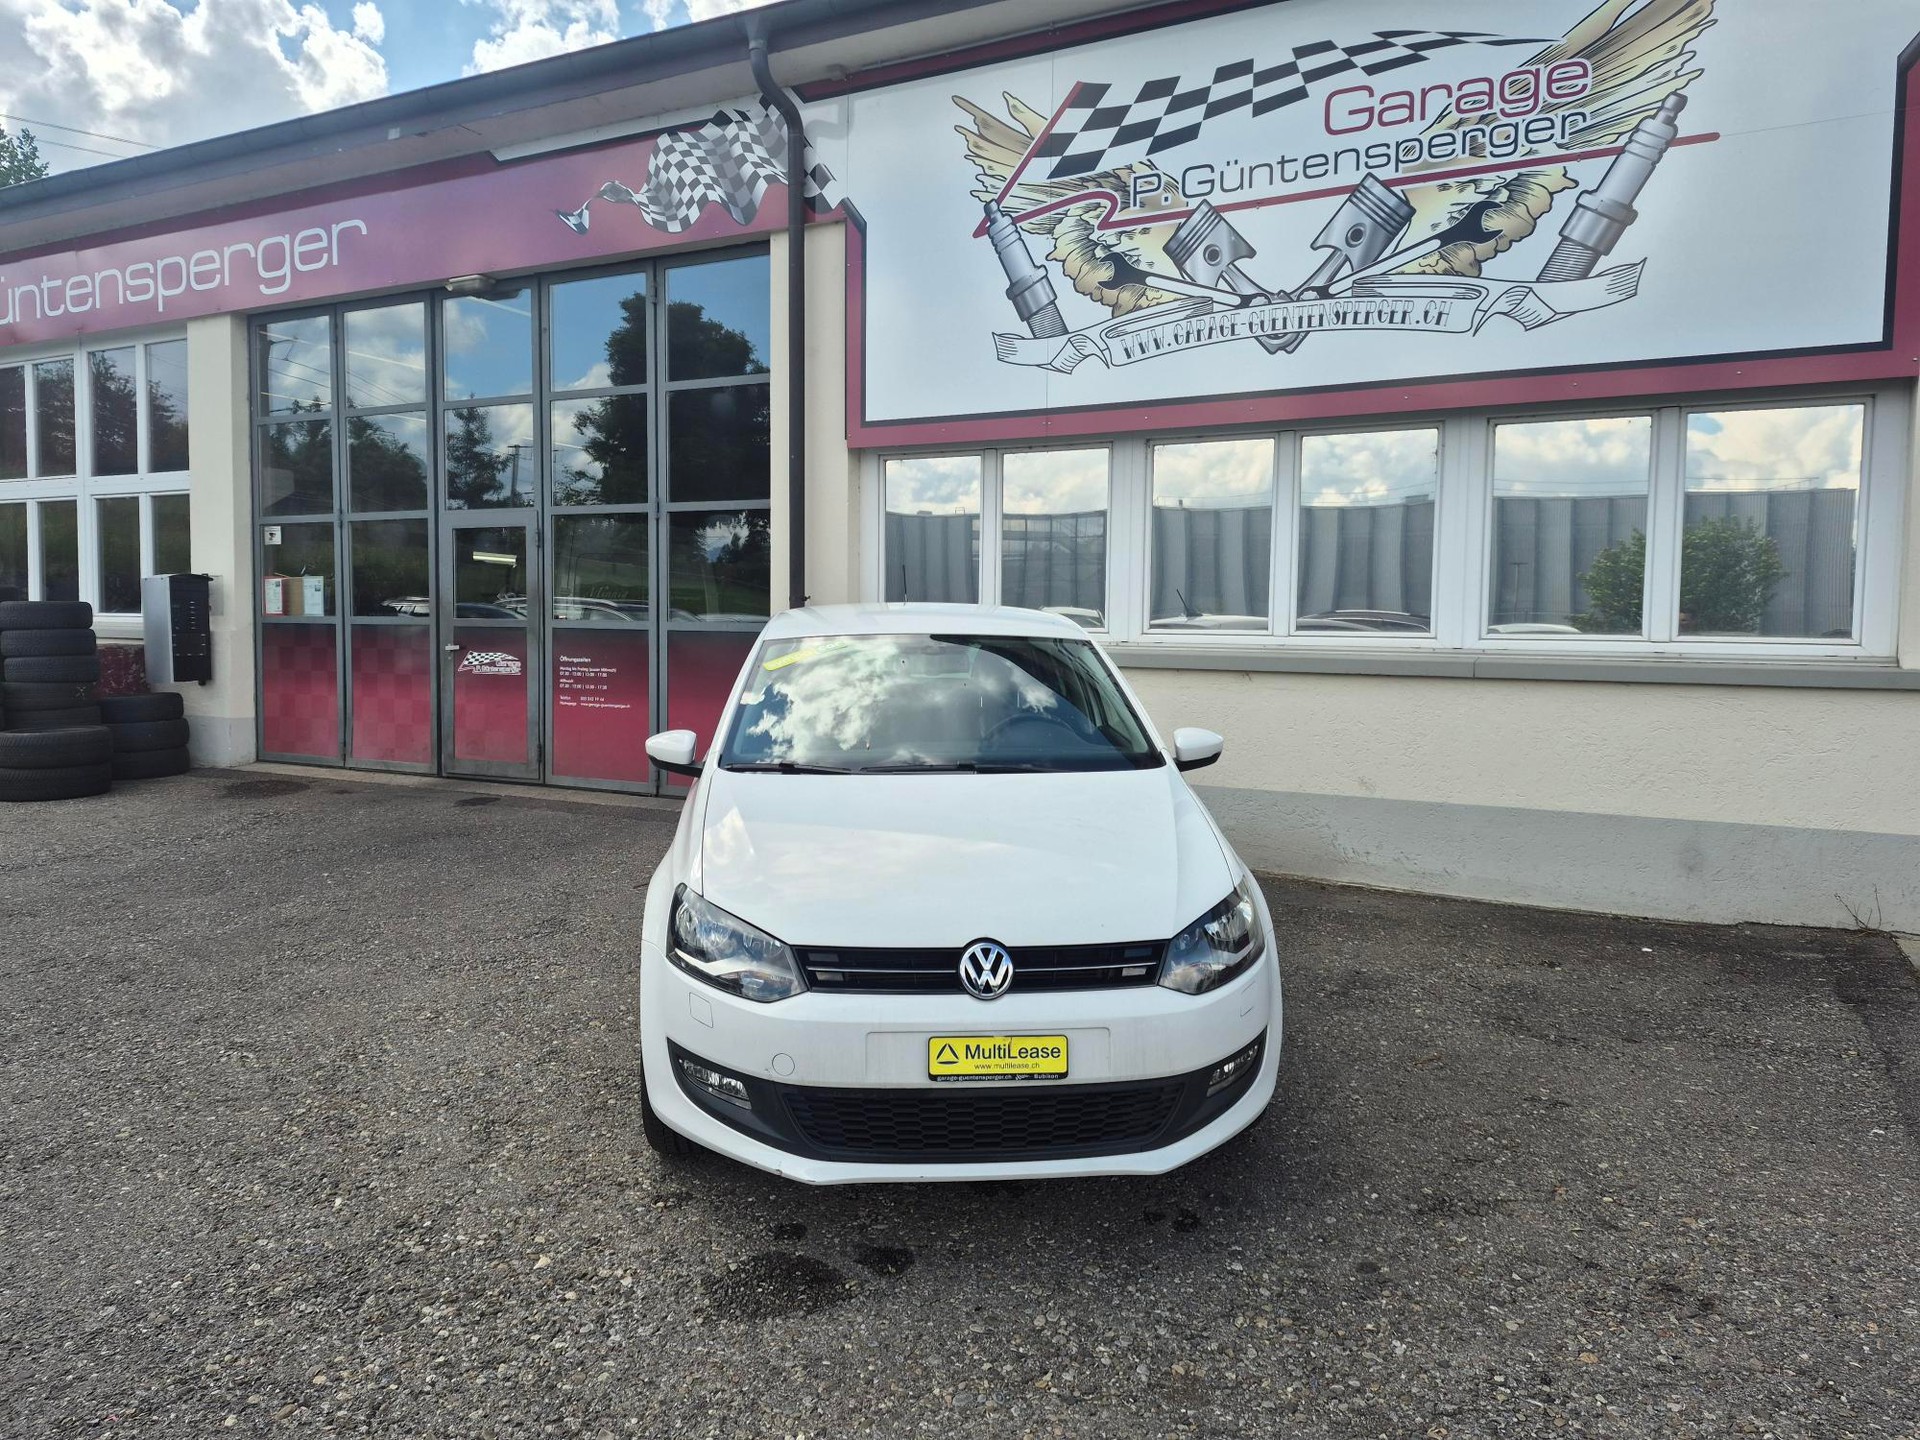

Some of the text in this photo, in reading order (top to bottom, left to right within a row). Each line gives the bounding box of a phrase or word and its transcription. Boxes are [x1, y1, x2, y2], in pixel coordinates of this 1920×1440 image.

[1324, 61, 1590, 136] Garage
[1131, 110, 1587, 207] P. Güntensperger
[965, 1044, 1061, 1060] MultiLease
